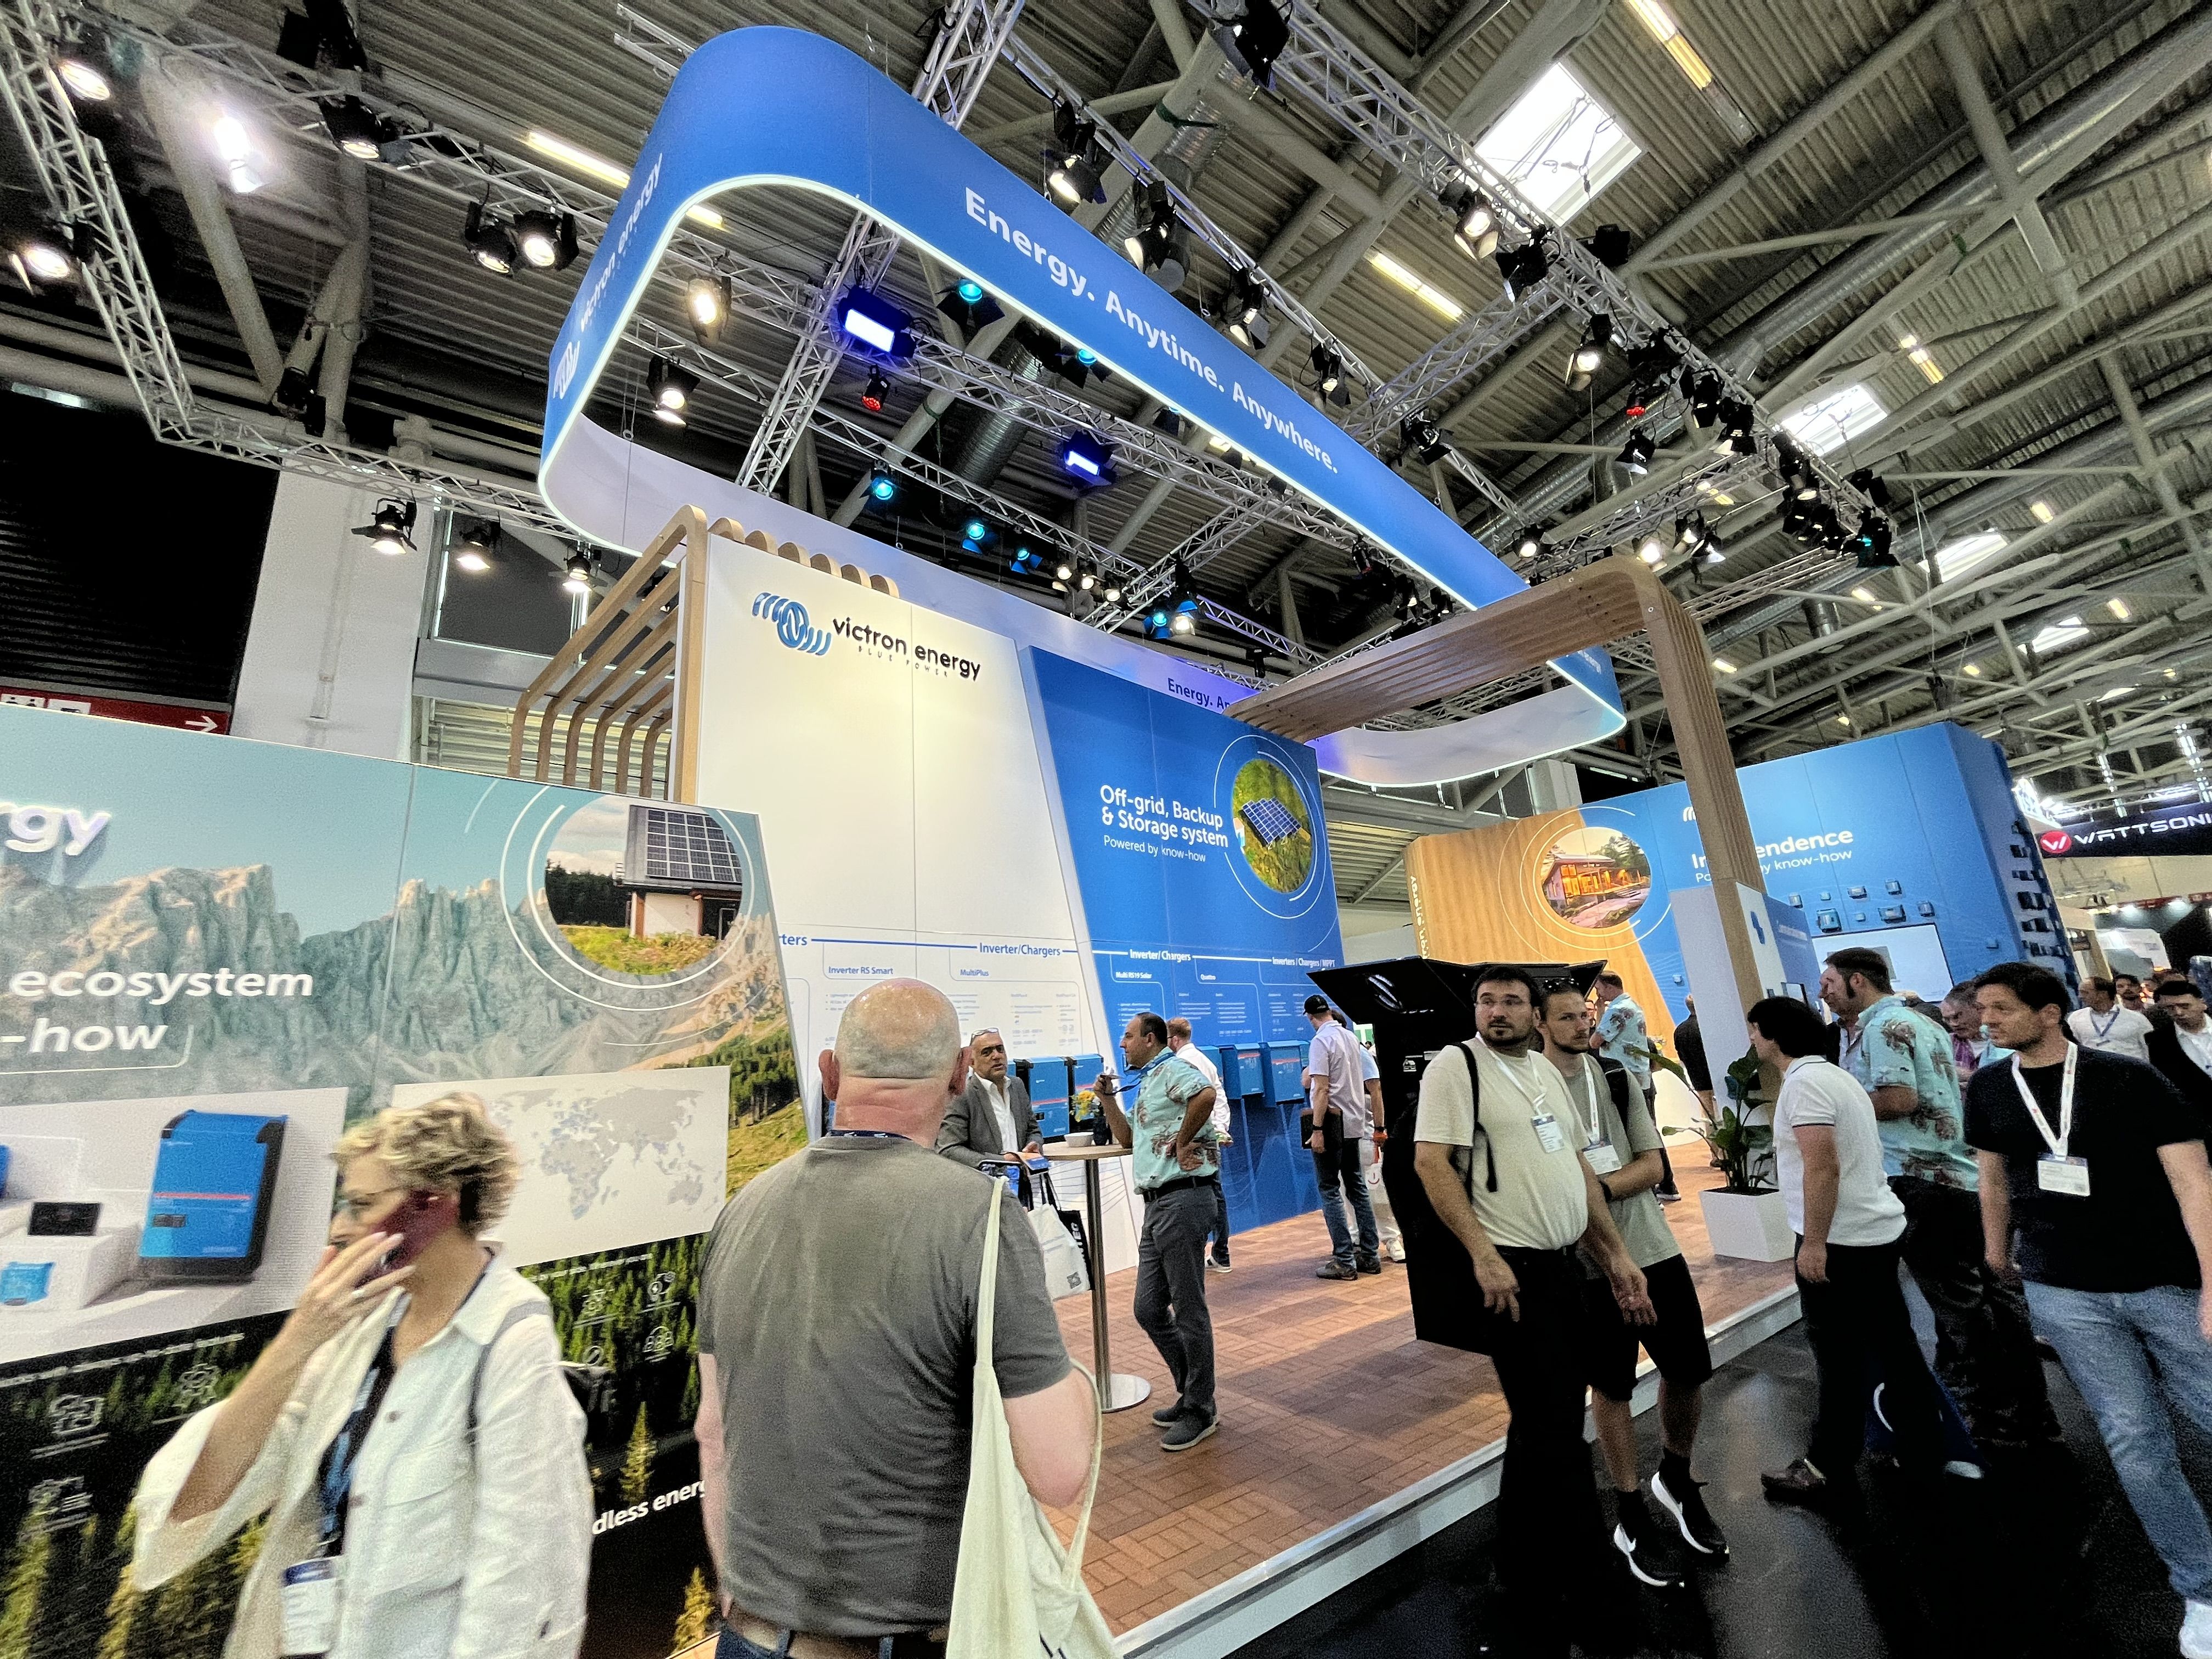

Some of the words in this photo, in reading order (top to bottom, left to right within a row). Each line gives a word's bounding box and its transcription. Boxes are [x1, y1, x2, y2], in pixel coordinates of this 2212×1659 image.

[965, 187, 1094, 301] Energy.
[1105, 291, 1225, 392] Anytime.
[1233, 381, 1338, 473] Anywhere.
[833, 617, 906, 655] victron
[915, 645, 981, 681] energy
[859, 646, 892, 661] BLUE
[906, 659, 947, 677] POWER
[1167, 678, 1213, 708] Energy.
[1100, 785, 1169, 818] Off-grid,
[1173, 801, 1223, 831] Backup
[1102, 806, 1114, 825] &
[1119, 810, 1178, 840] Storage
[1182, 826, 1228, 848] system
[2074, 813, 2212, 844] WATTSONI
[1104, 835, 1145, 853] Powered
[1148, 842, 1158, 857] by
[1161, 844, 1206, 862] know-how
[1691, 830, 1853, 869] Inendence
[1774, 850, 1852, 870] know-how
[979, 943, 1060, 956] Inverter/Chargers
[10, 968, 313, 1005] ecosystem
[592, 1500, 649, 1535] dless
